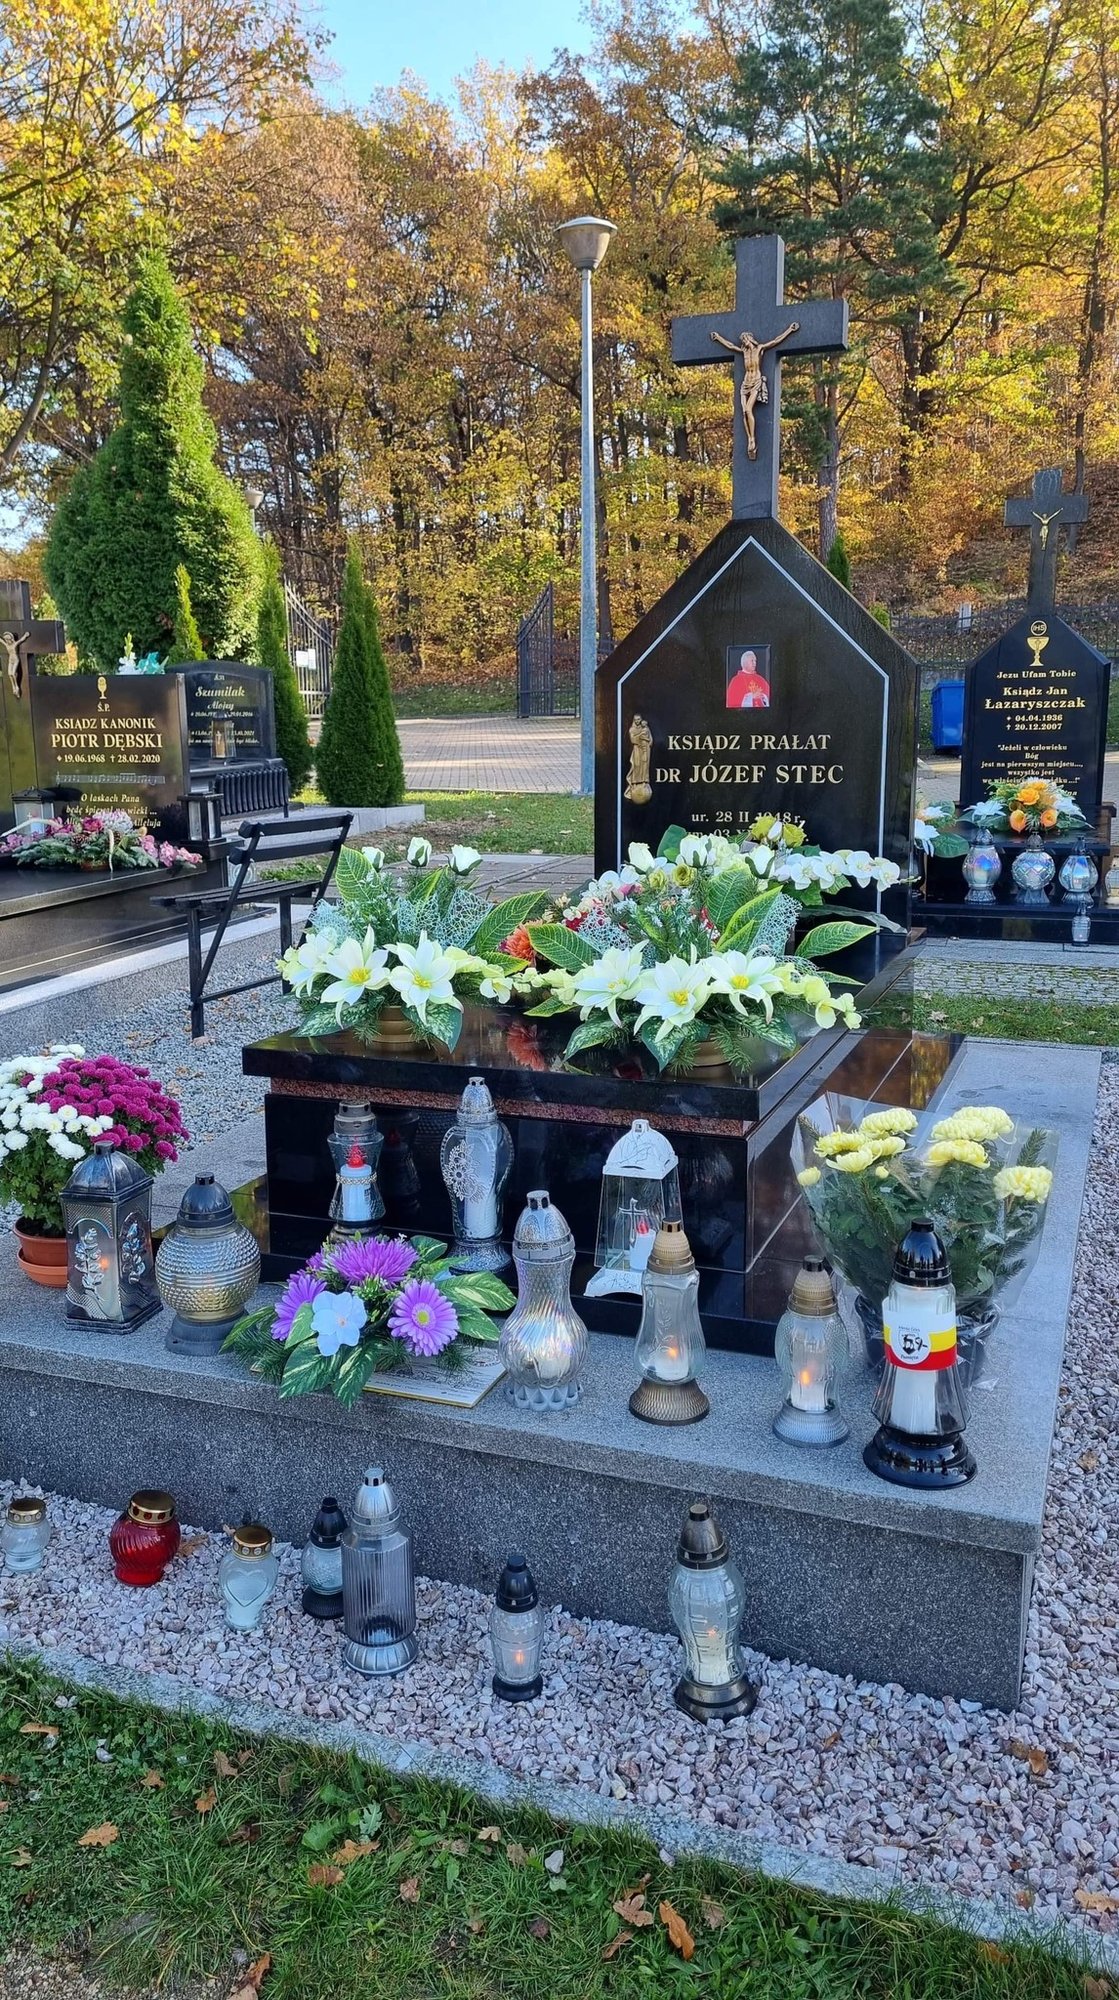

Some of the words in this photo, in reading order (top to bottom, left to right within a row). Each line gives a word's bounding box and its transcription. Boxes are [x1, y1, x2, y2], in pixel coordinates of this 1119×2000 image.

[996, 671, 1019, 679] Jezu
[1021, 670, 1047, 678] Ufam
[1049, 669, 1077, 677] Tobie
[195, 685, 246, 697] Szumilak
[1003, 686, 1042, 697] Ksiądz
[1045, 686, 1068, 695] Jan
[984, 696, 1086, 711] Łazaryszczak
[1014, 713, 1063, 722] 04.04.1936
[55, 717, 98, 731] KSIĄDZ
[100, 717, 156, 729] KANONIK
[1014, 722, 1063, 731] 20.12.2007
[51, 733, 100, 748] PIOTR
[103, 733, 163, 751] DĘBSKI
[667, 734, 741, 754] KSIĄDZ
[750, 734, 832, 750] PRAŁAT
[64, 753, 106, 763] 19.06.1968
[117, 753, 161, 763] 28.02.2020
[1025, 752, 1040, 760] Bóg
[981, 760, 995, 768] jest
[655, 767, 681, 783] DR
[689, 758, 767, 784] JÓZEF
[775, 764, 844, 784] STEC
[1040, 769, 1055, 777] jest
[80, 793, 88, 801] O
[121, 794, 140, 803] Pana
[691, 813, 709, 822] ur.
[715, 811, 733, 823] 28
[739, 811, 750, 823] II
